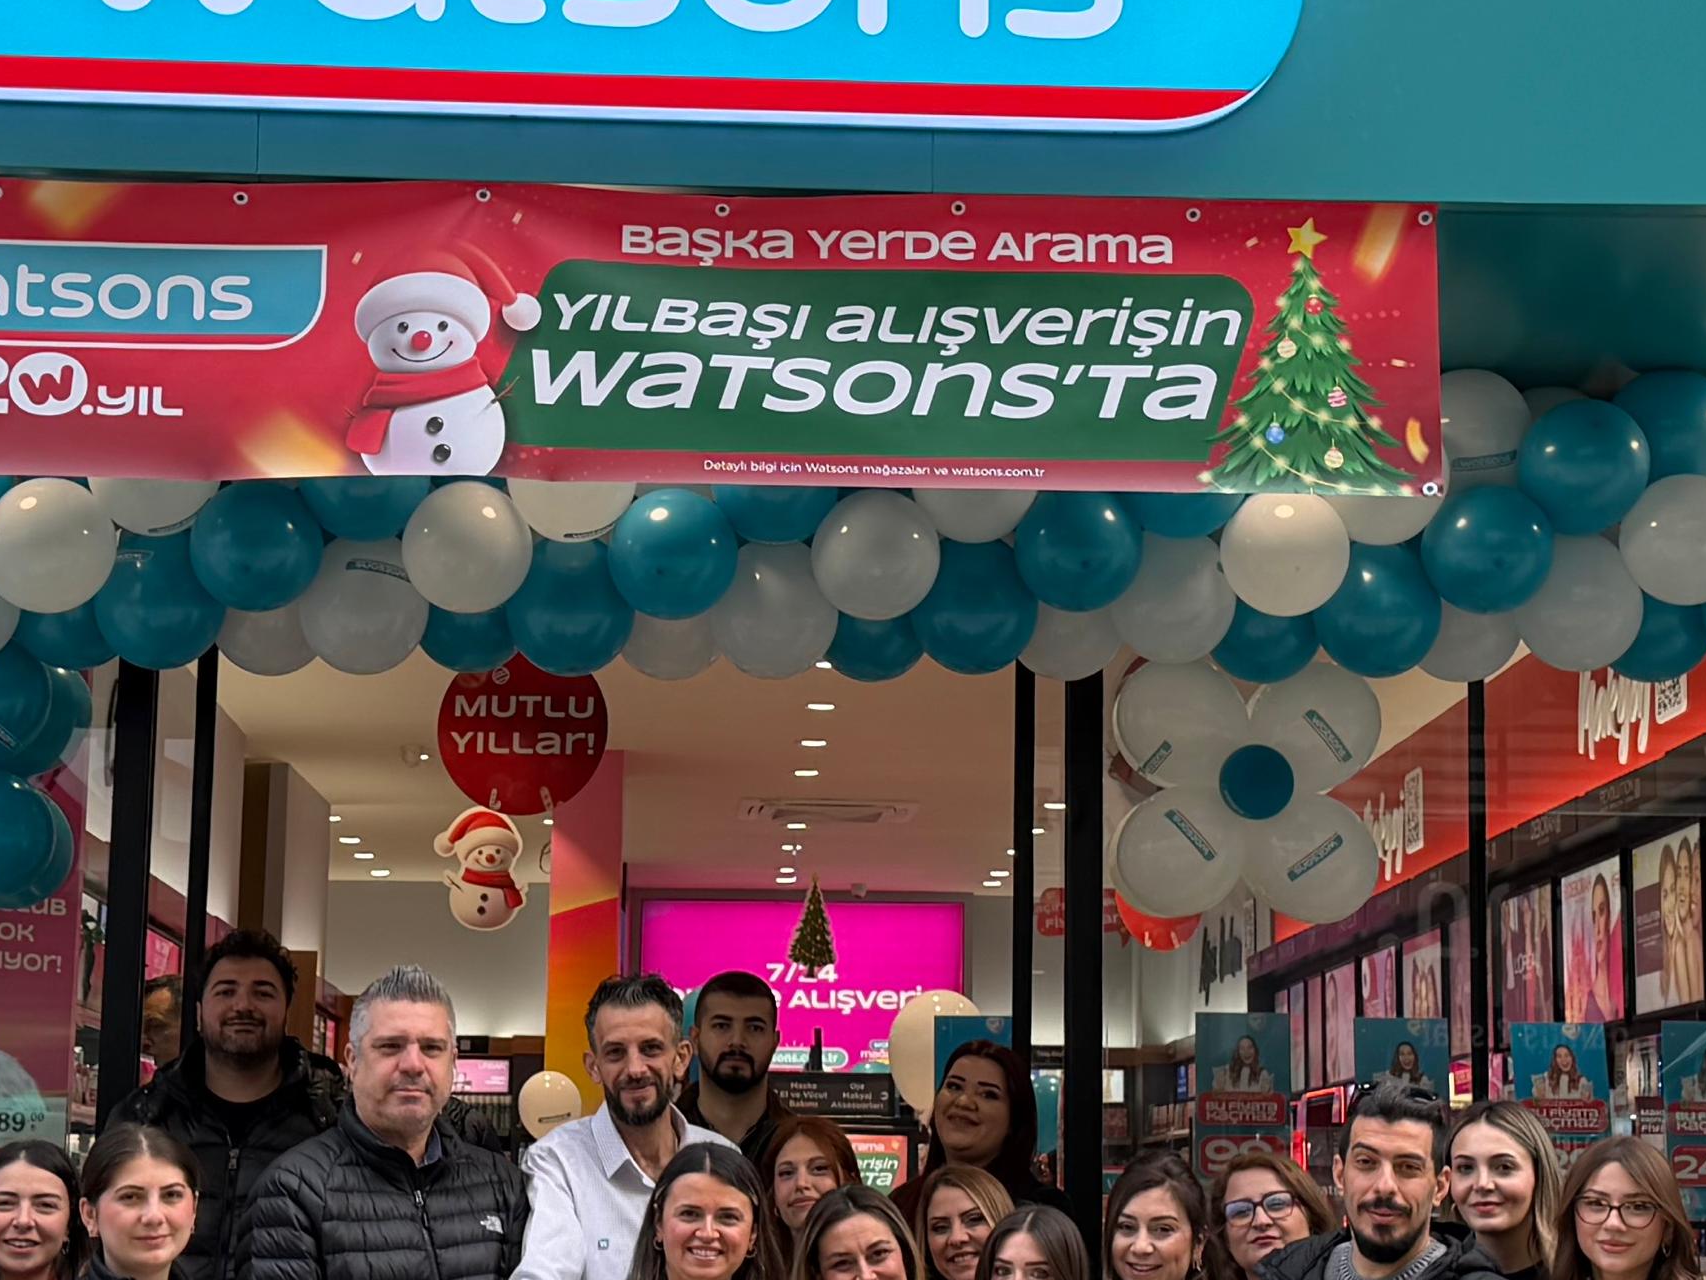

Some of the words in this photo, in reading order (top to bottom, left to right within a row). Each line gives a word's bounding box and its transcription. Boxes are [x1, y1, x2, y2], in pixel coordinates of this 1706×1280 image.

[703, 459, 747, 473] Detaylı
[750, 460, 777, 474] bilgi
[780, 460, 802, 474] için
[805, 461, 859, 474] Watsons
[862, 463, 931, 477] mağazaları
[934, 467, 949, 476] ve
[951, 466, 1045, 478] watsons.com.tr
[454, 695, 595, 719] MUTLU
